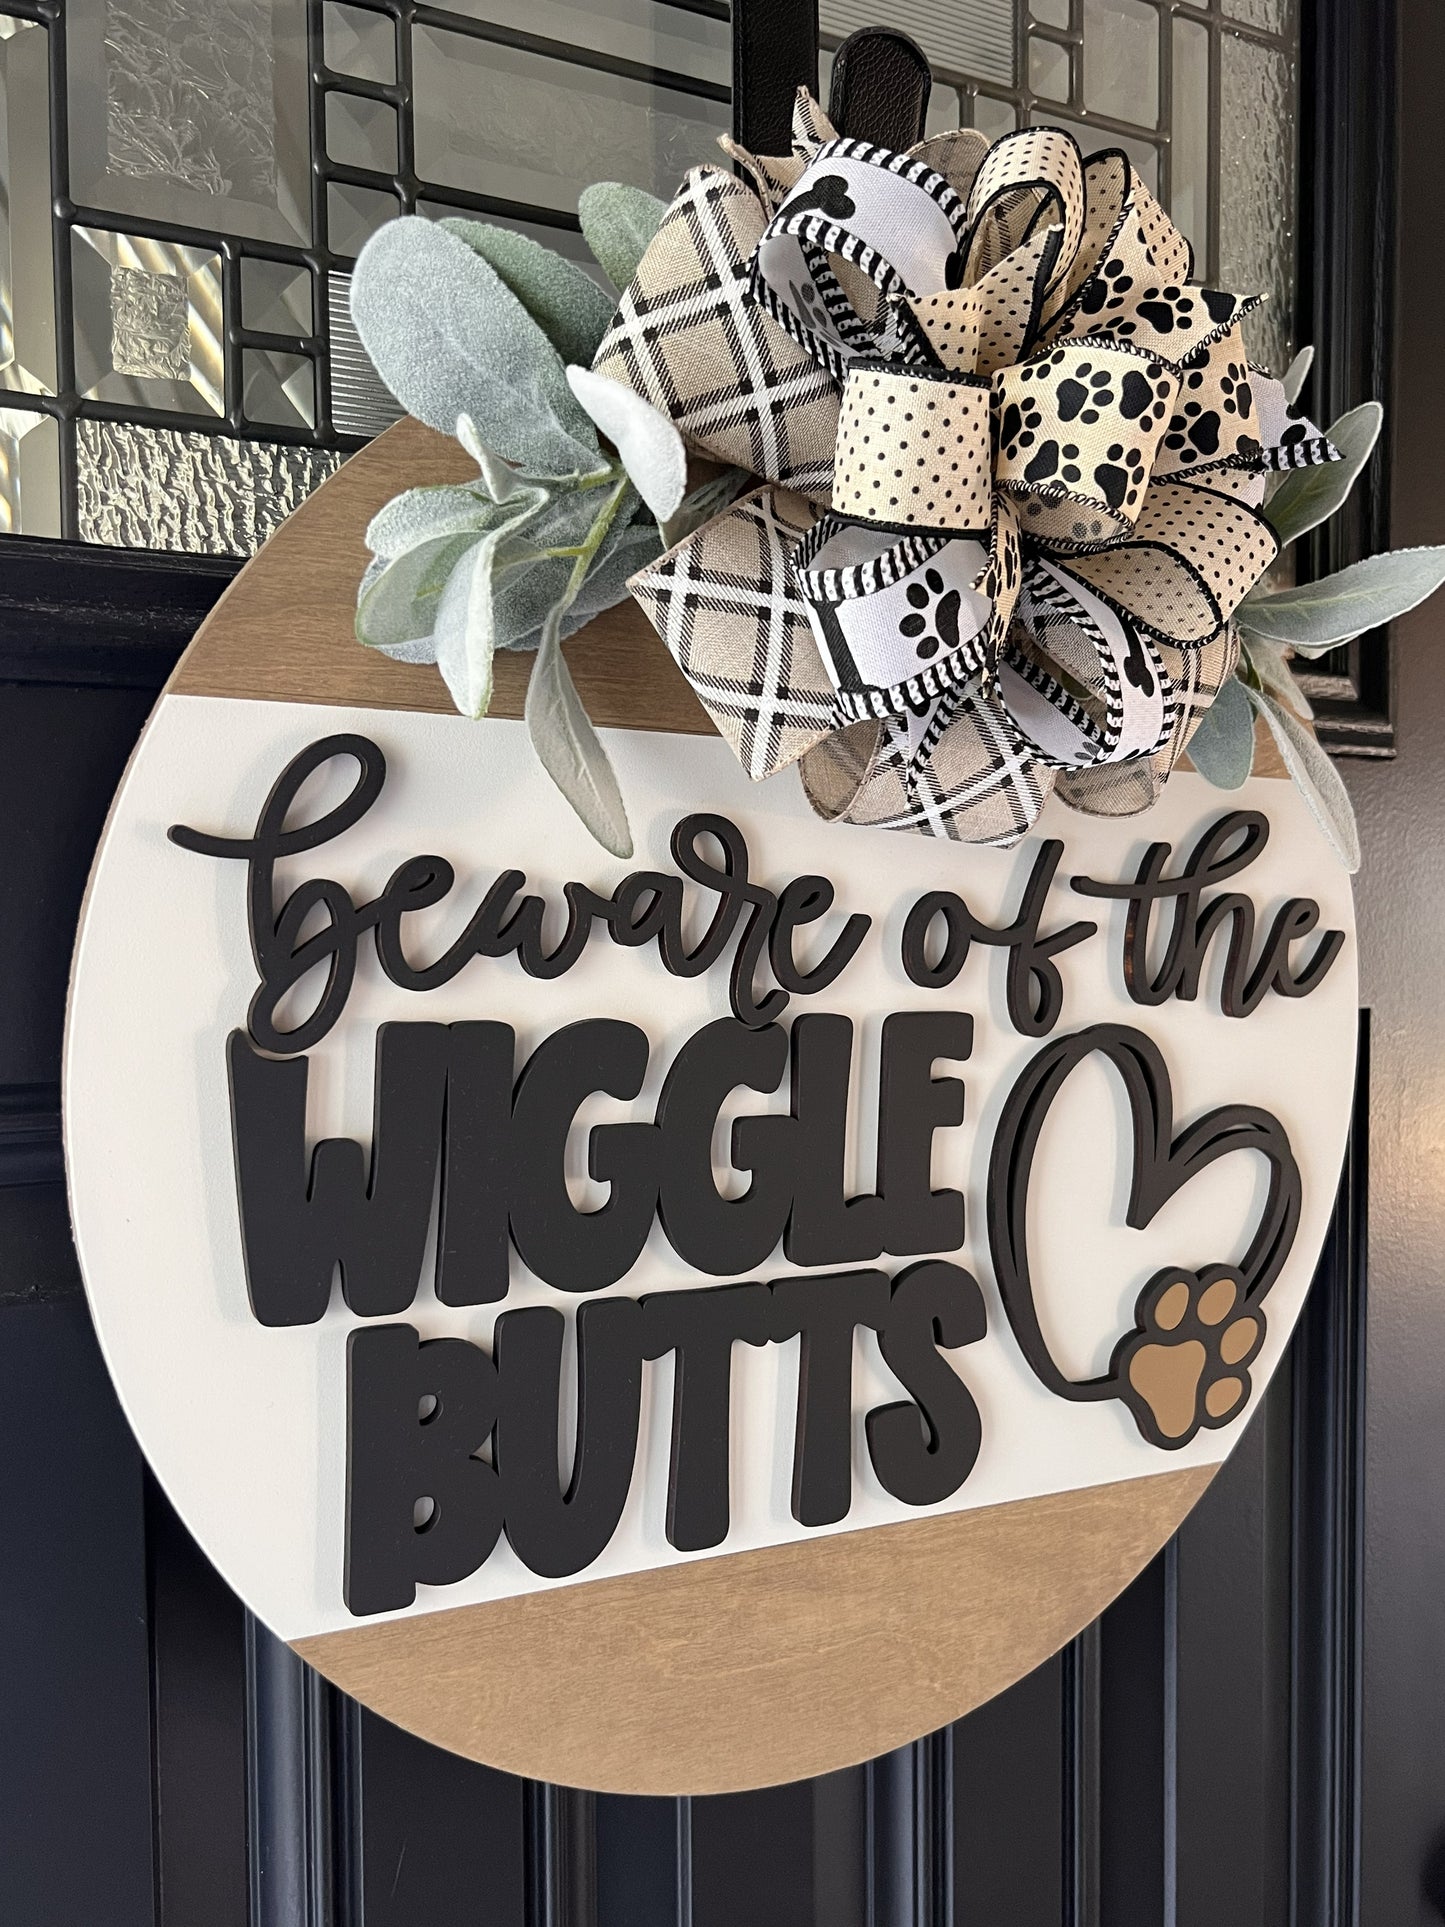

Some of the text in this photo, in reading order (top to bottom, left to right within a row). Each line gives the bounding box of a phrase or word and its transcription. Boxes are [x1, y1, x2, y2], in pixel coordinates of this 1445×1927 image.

[167, 733, 1345, 1054] beware of the
[226, 1012, 974, 1327] WIGGLE
[344, 1259, 987, 1616] BUTTS
